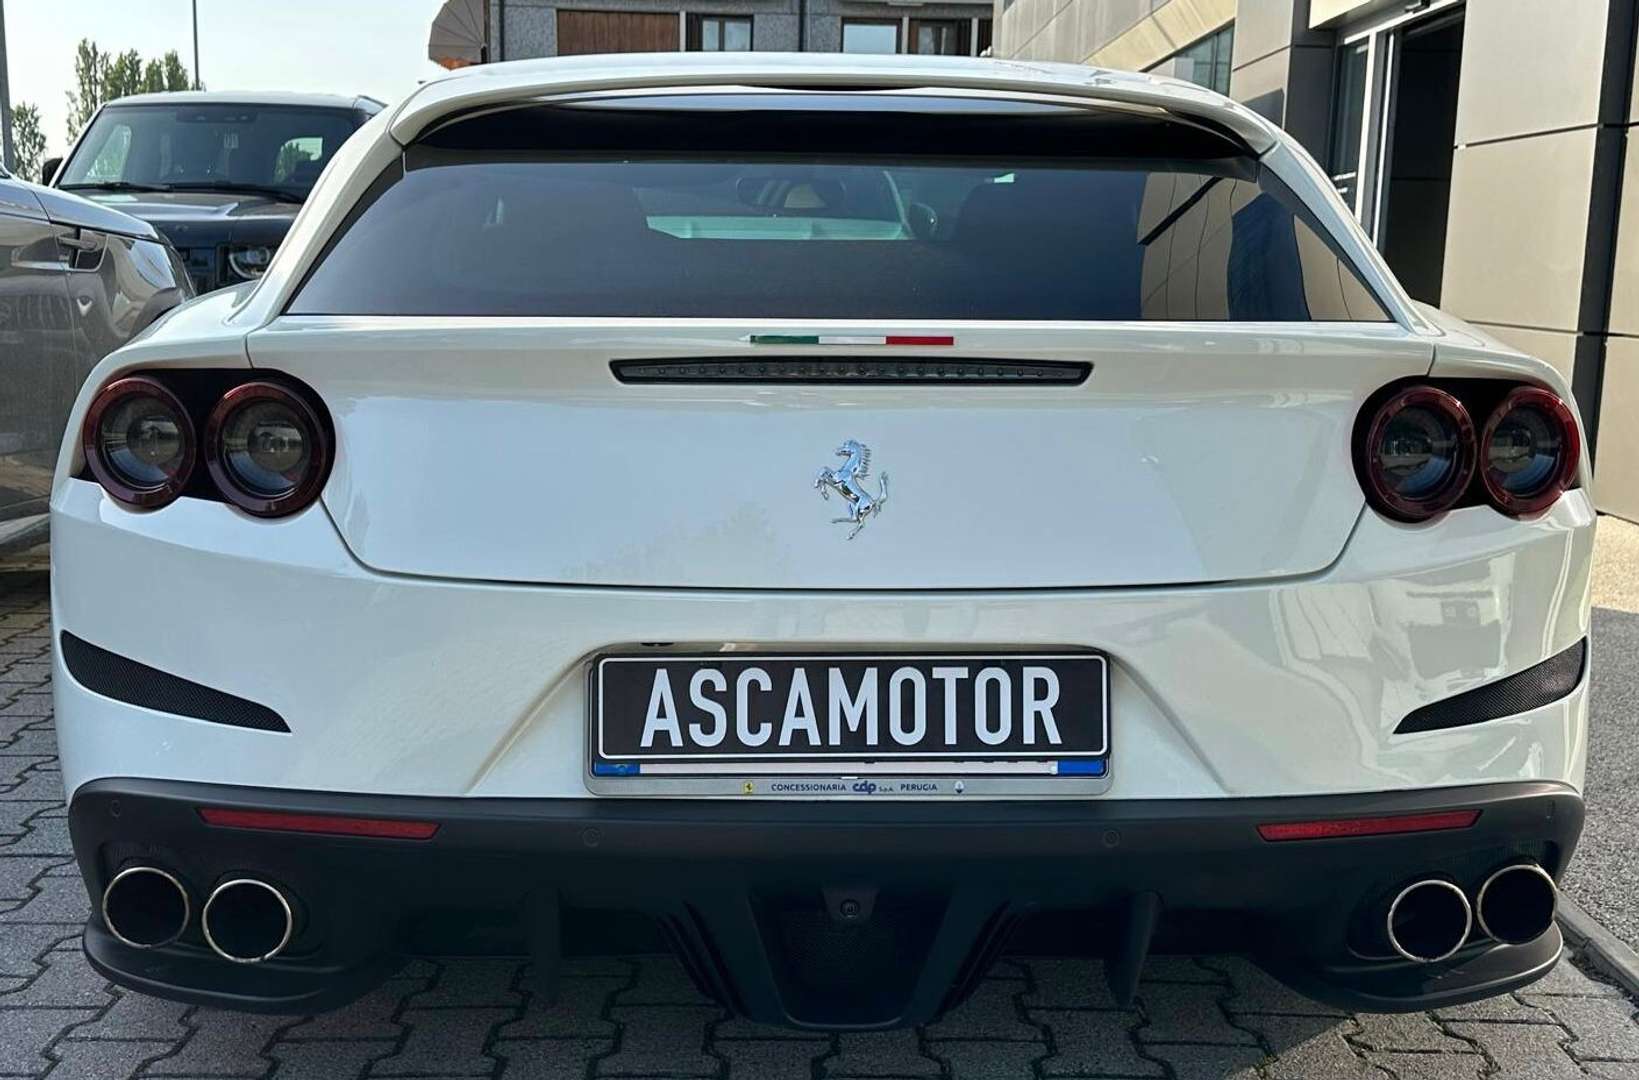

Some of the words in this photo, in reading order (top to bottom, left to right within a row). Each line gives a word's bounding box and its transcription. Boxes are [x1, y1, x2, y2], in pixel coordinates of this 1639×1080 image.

[640, 666, 1063, 748] ASCAMOTOR
[771, 783, 847, 791] CONCESSIONARIA
[852, 780, 877, 795] cdp
[900, 783, 937, 791] PERUGIA
